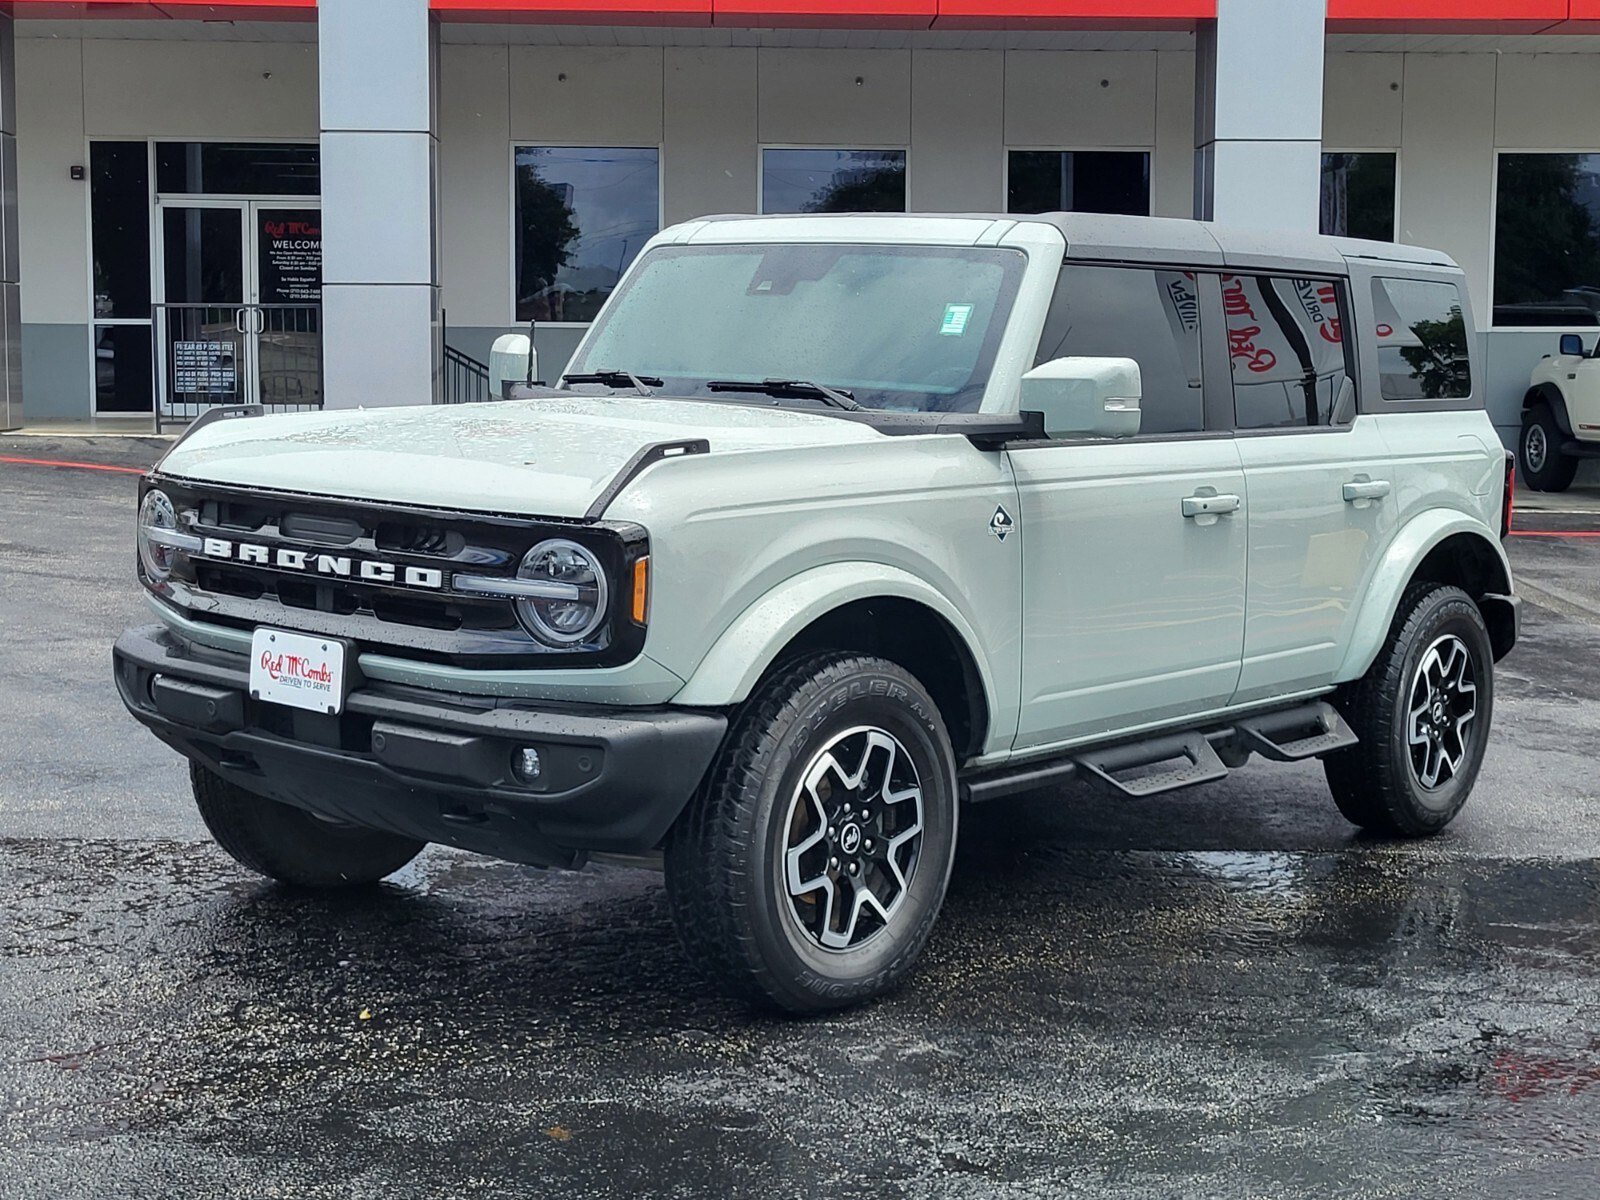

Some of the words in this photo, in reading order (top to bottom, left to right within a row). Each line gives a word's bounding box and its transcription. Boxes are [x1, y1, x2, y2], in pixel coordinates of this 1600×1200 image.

[272, 240, 321, 249] WELCOM
[204, 538, 442, 588] BRONCO
[260, 650, 283, 680] Red
[286, 655, 332, 683] McCombs
[279, 675, 302, 688] DRIVEN
[302, 680, 312, 688] TO
[312, 682, 331, 692] SERVE
